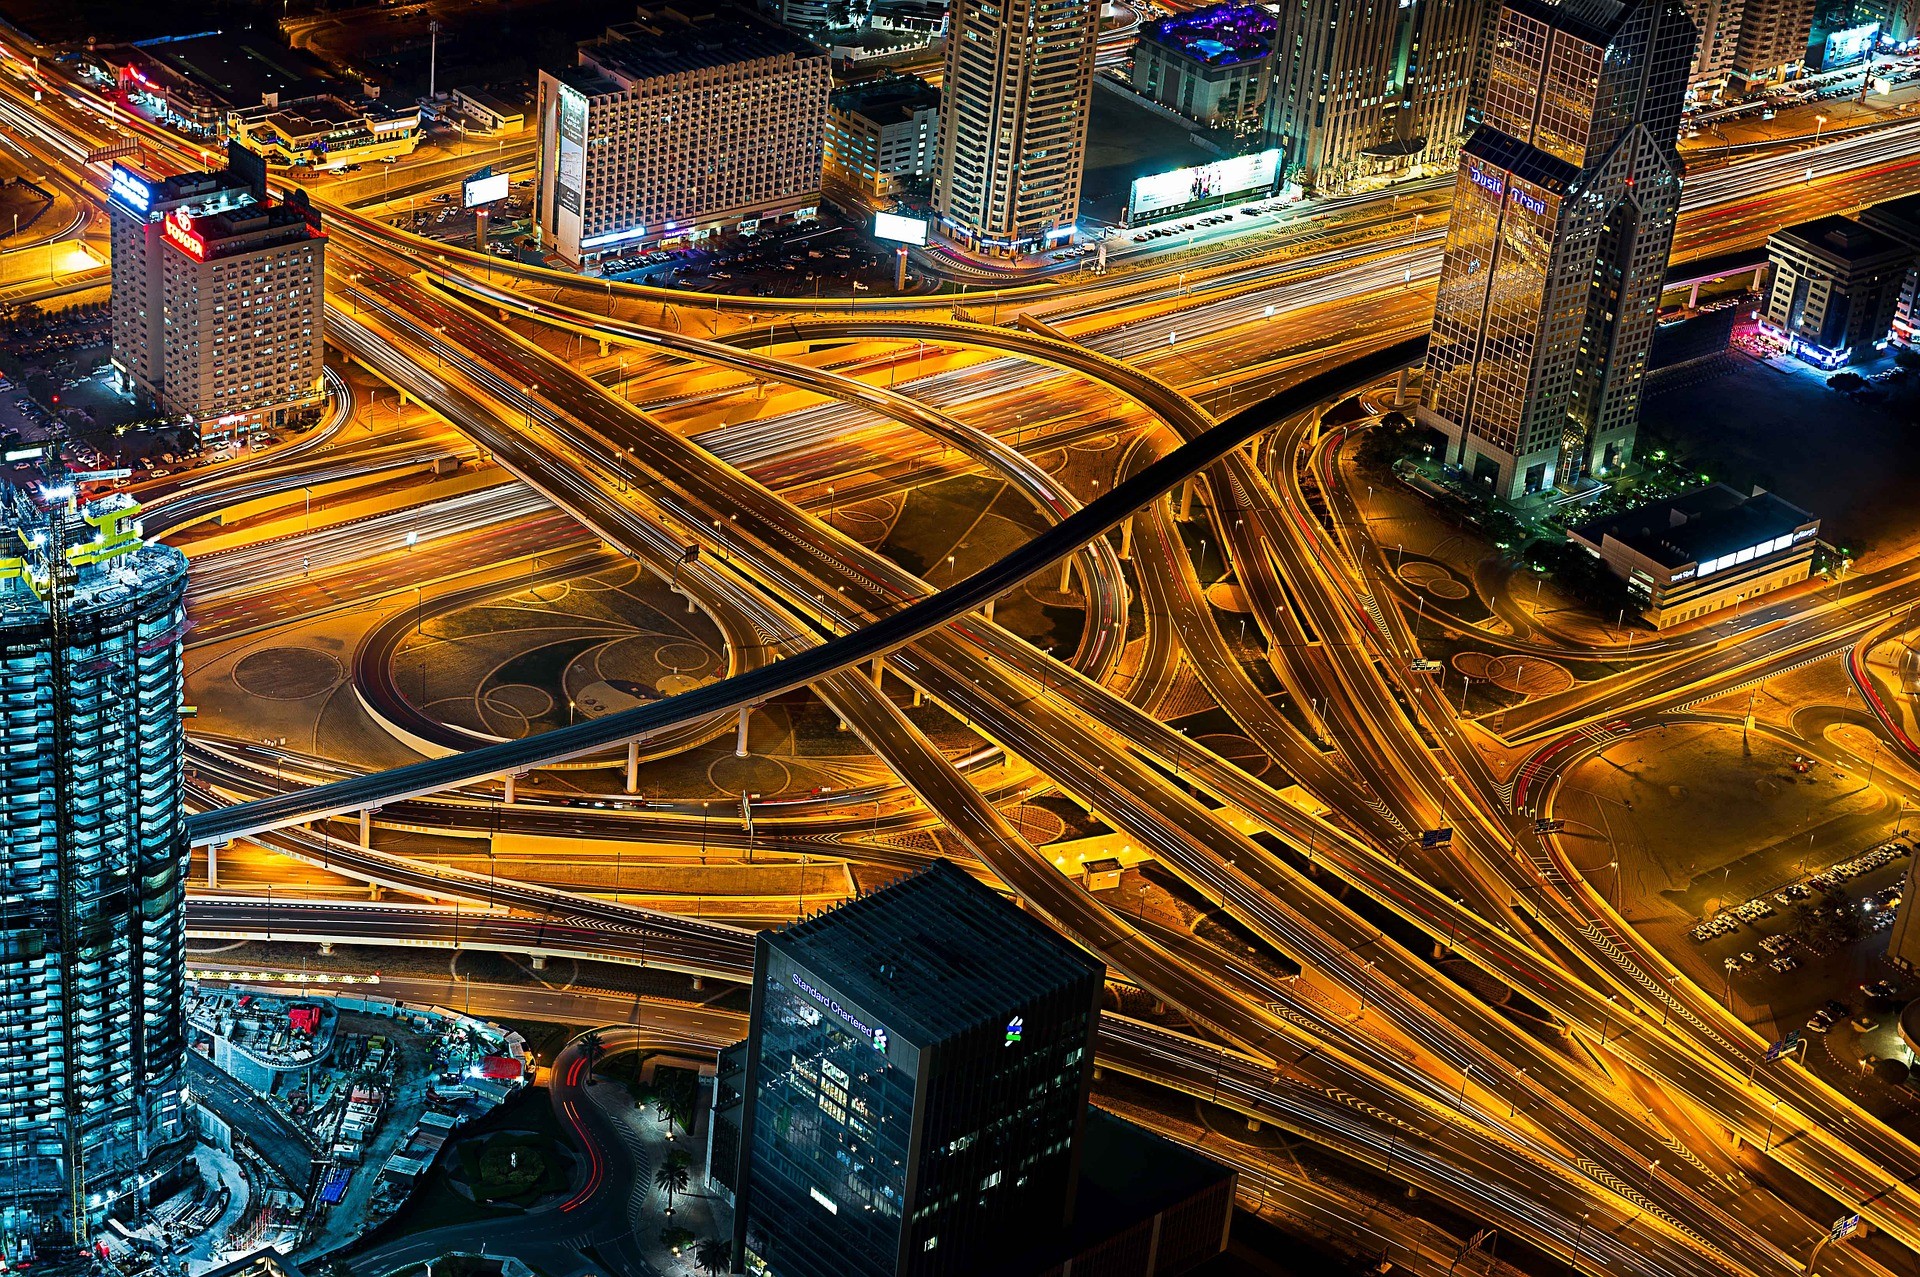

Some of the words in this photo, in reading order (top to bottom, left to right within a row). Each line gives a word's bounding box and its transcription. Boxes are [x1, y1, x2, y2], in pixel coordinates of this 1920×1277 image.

[1470, 166, 1502, 194] Dusit
[1511, 187, 1545, 215] Thani
[165, 214, 203, 258] TOYOTA
[792, 973, 830, 1007] Standard
[830, 1001, 873, 1038] Chartered
